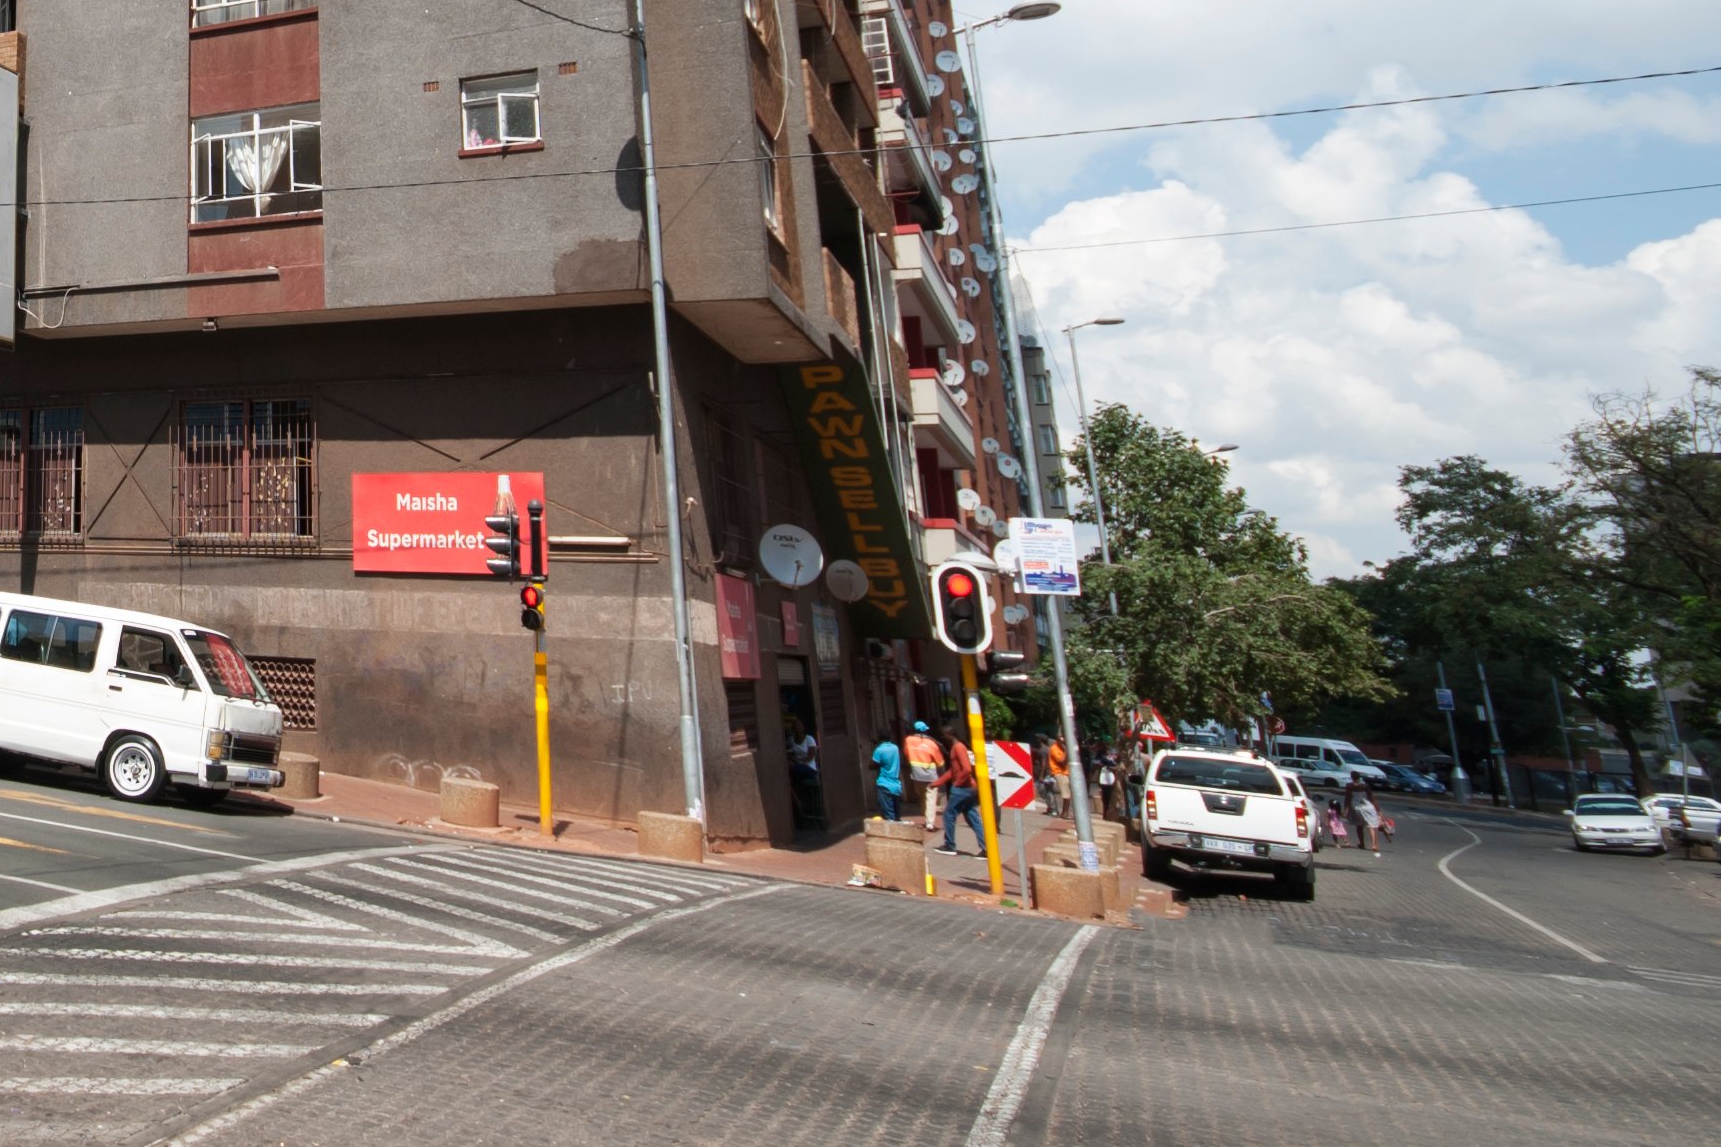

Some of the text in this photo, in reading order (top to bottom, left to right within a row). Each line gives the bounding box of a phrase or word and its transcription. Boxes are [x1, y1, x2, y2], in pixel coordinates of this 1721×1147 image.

[800, 365, 869, 459] PAWN
[396, 493, 458, 511] Maisha
[830, 465, 891, 556] SELL
[367, 529, 485, 550] Supermarket
[859, 557, 909, 618] BUY
